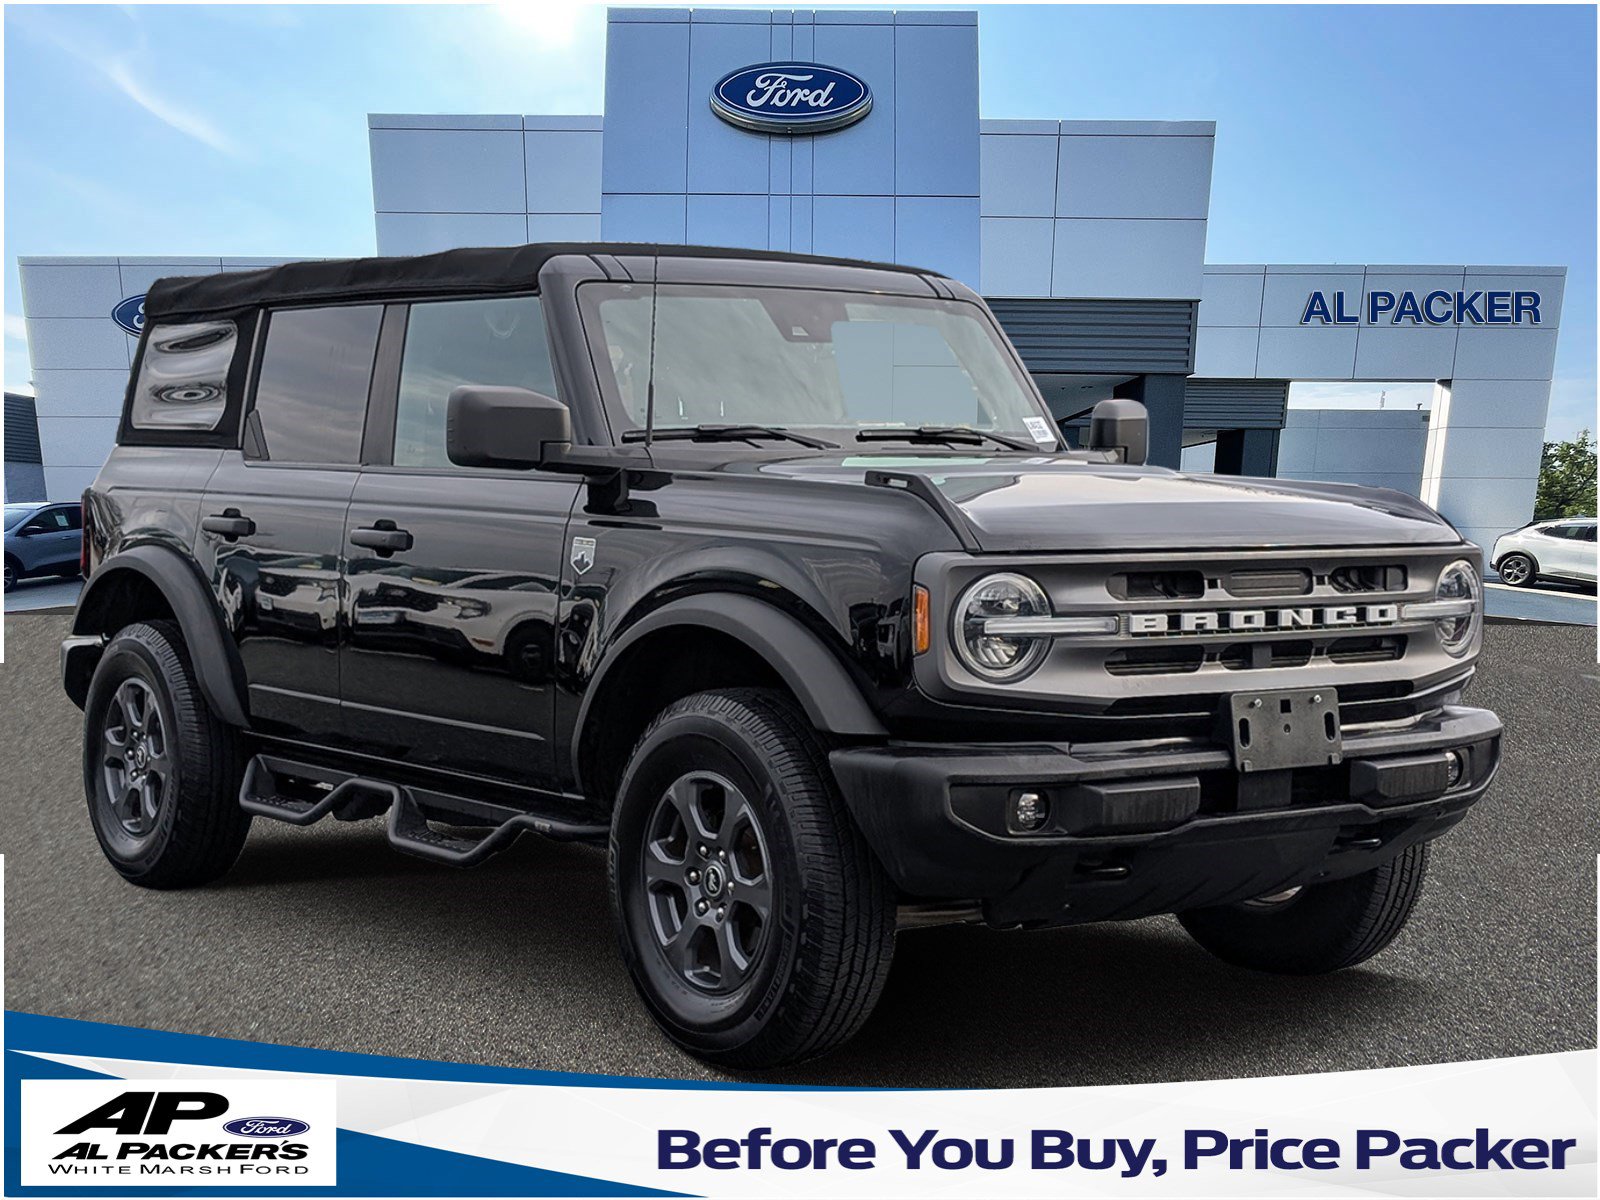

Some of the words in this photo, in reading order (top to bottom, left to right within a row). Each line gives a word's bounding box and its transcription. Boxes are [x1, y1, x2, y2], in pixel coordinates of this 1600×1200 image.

[746, 73, 834, 108] Ford
[1302, 291, 1360, 325] AL
[1369, 290, 1542, 325] PACKER
[1129, 603, 1399, 635] BRONCO
